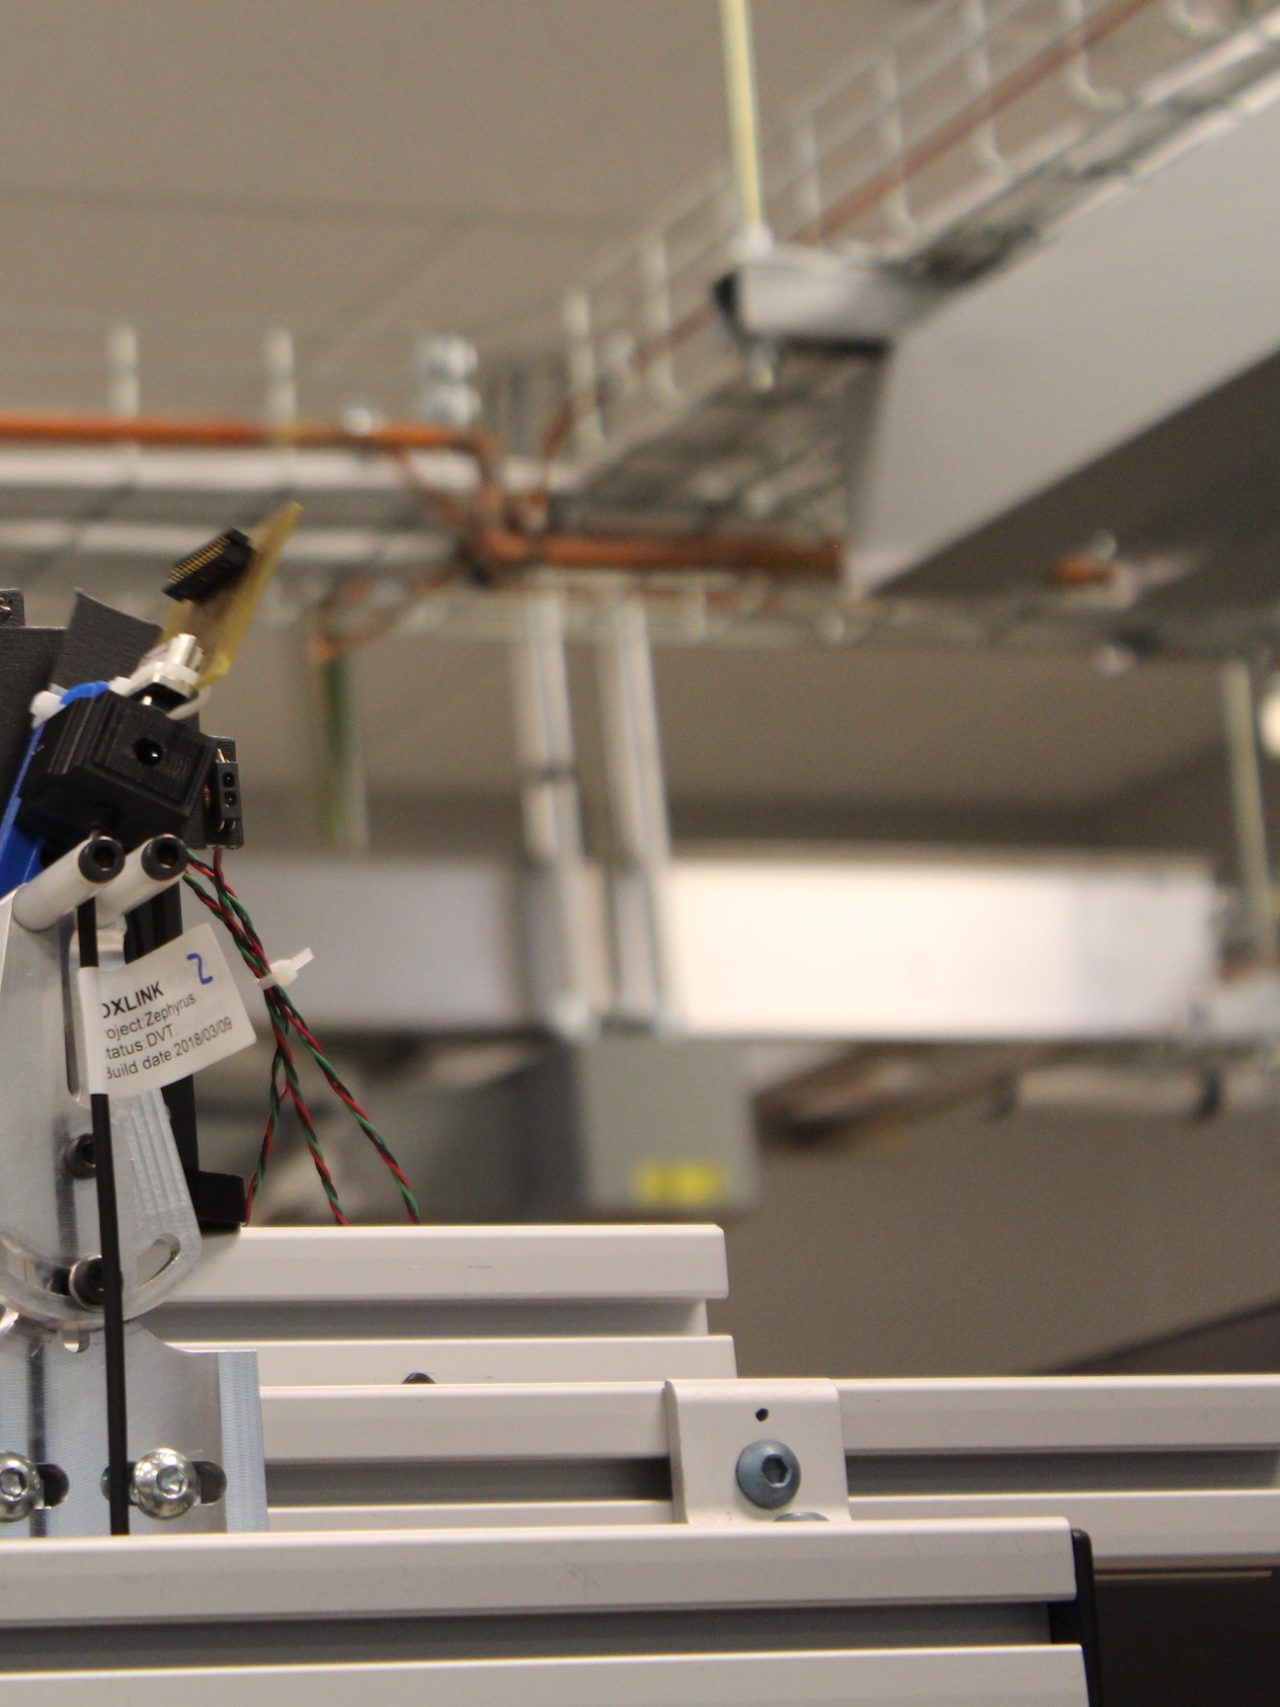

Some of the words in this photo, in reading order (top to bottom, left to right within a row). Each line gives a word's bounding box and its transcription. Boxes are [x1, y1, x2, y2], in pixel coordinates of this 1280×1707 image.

[101, 980, 164, 1019] OXLINK
[105, 1016, 142, 1042] oject
[105, 1040, 144, 1060] tatus
